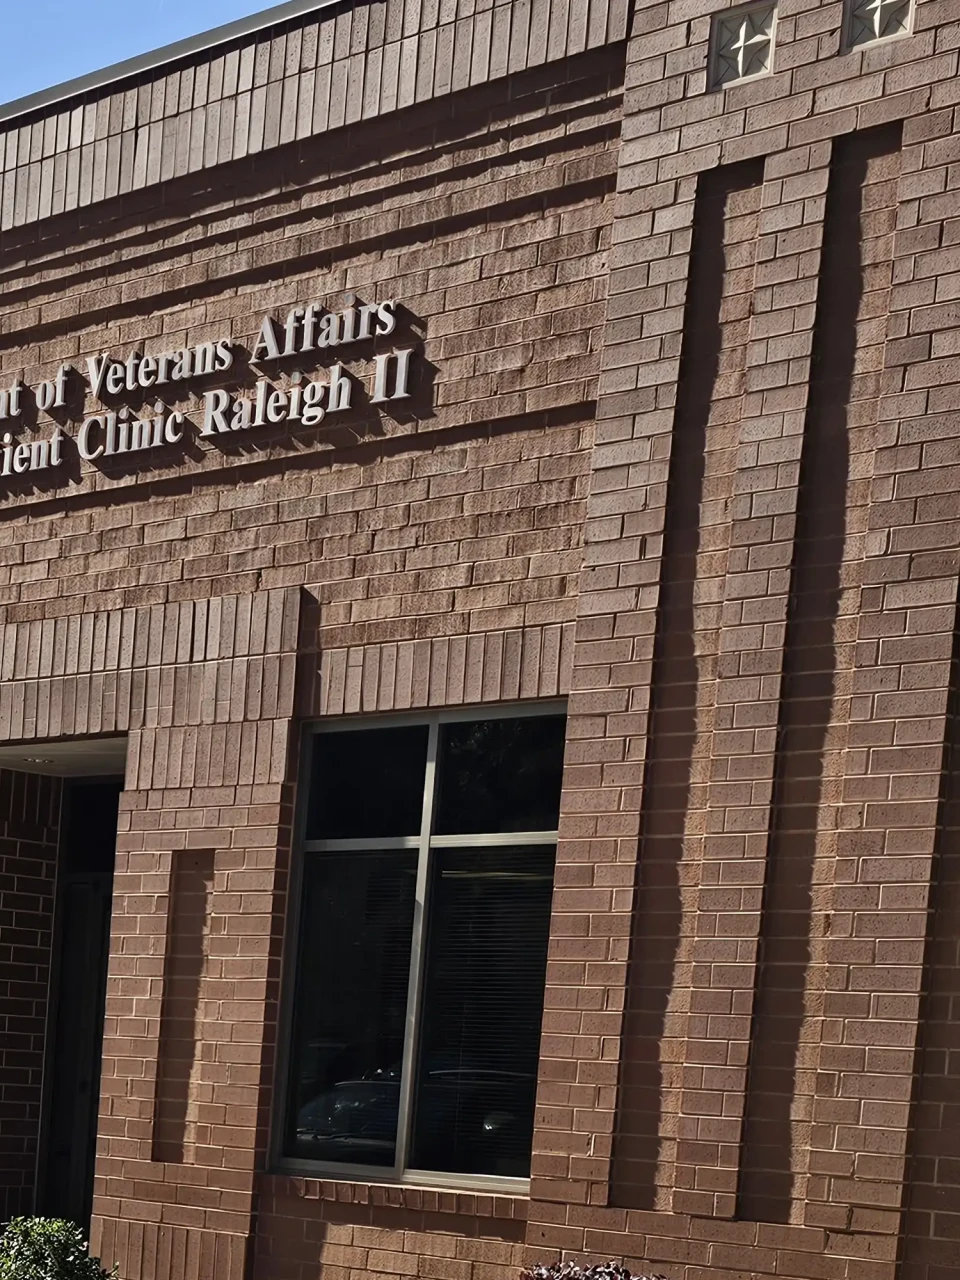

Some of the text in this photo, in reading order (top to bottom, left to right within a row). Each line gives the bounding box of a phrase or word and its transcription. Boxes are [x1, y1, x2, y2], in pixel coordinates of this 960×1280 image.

[35, 364, 69, 411] of
[85, 336, 233, 398] Veterans
[249, 296, 398, 364] Affairs
[78, 406, 185, 461] Clinic
[200, 367, 351, 437] Raleigh
[370, 348, 414, 404] II
